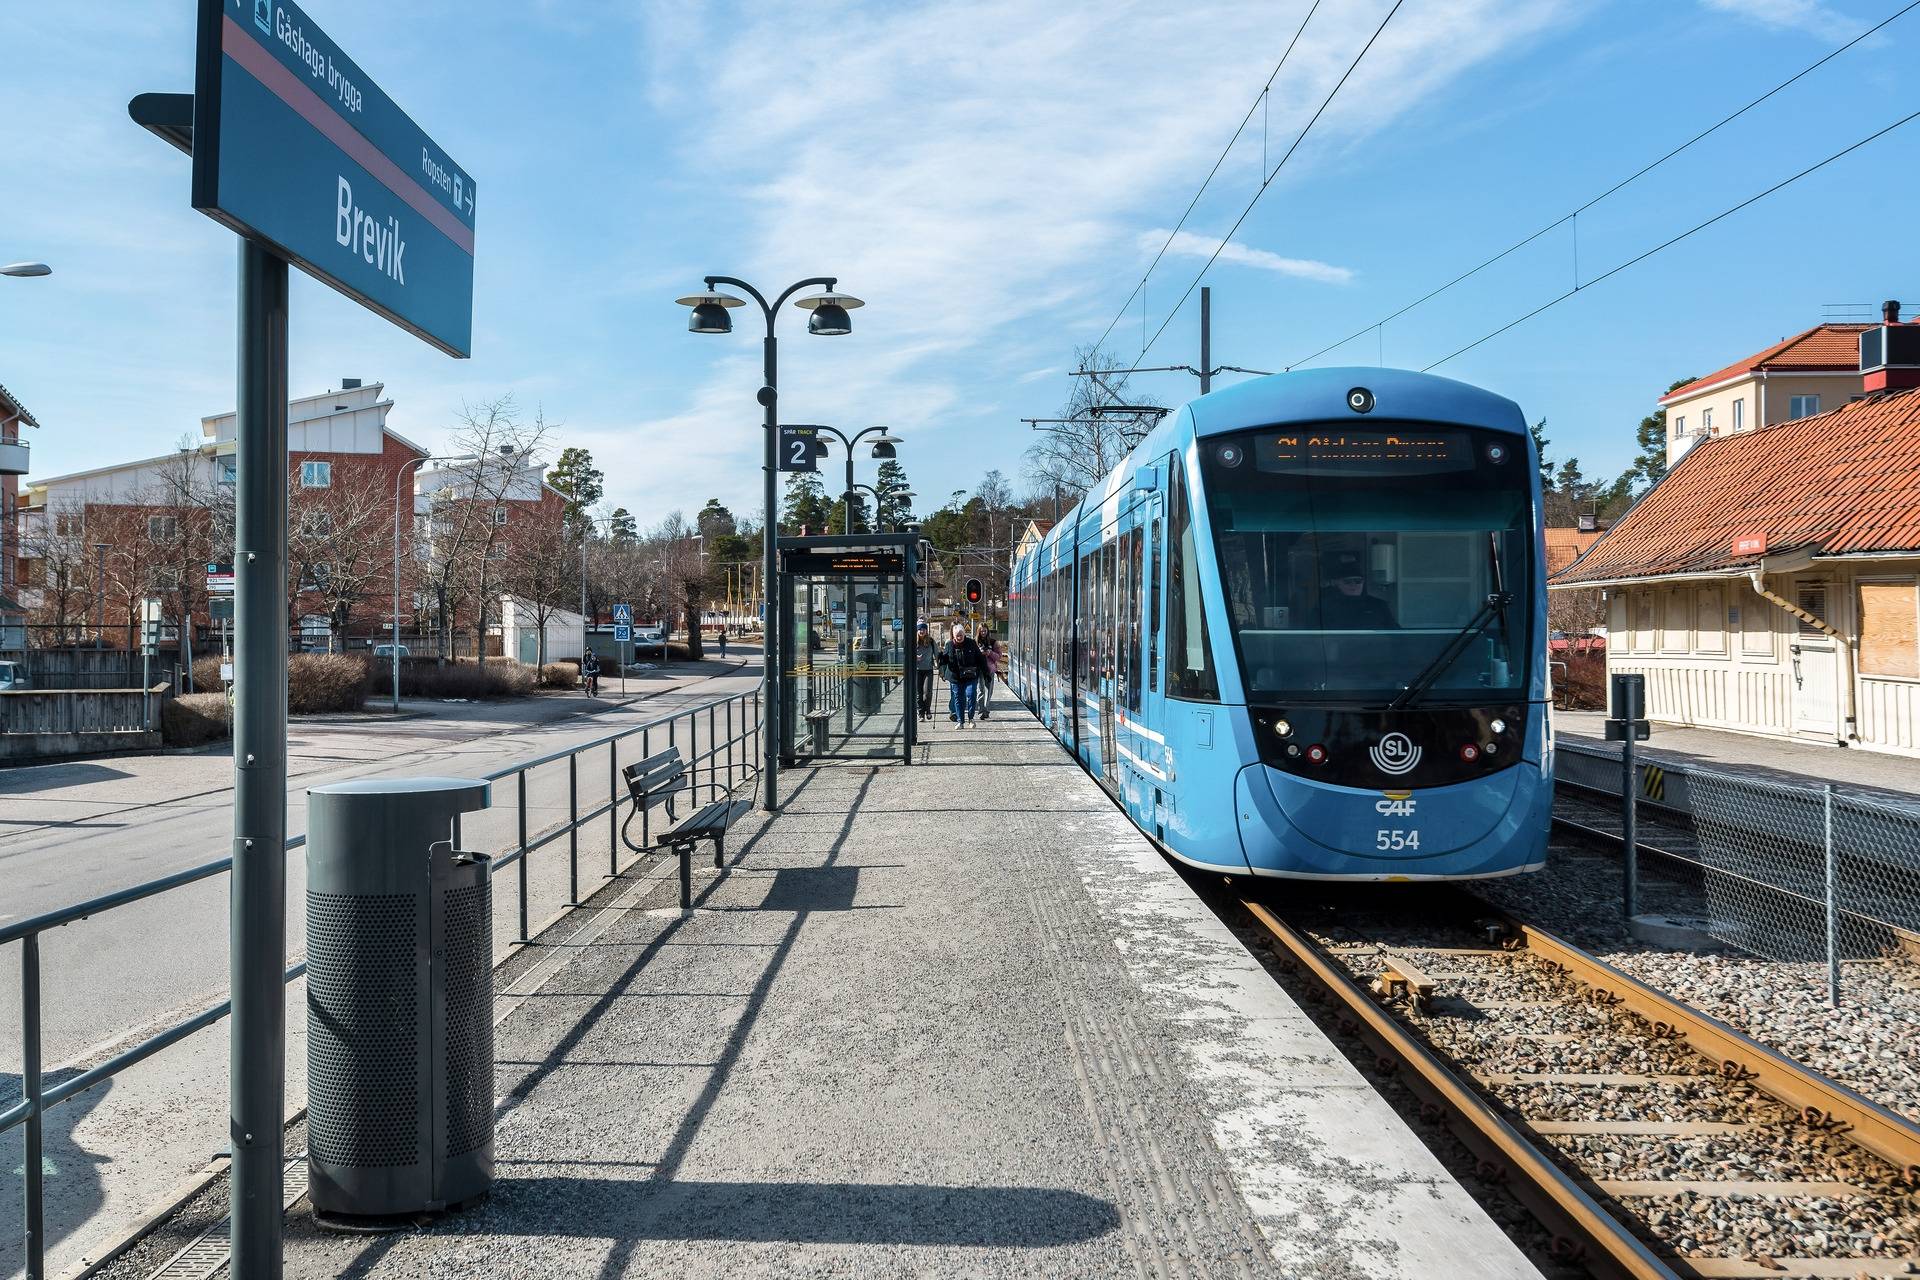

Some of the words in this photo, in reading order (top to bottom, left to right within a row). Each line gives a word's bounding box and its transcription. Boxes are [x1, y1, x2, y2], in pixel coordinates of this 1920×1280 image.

[276, 6, 325, 79] Gåshaga
[328, 55, 362, 113] brygga
[422, 146, 452, 195] Ropsten
[336, 175, 406, 286] Brevik
[790, 440, 806, 464] 2
[1385, 740, 1408, 757] SL
[1375, 800, 1417, 817] CAF
[1376, 829, 1420, 851] 554
